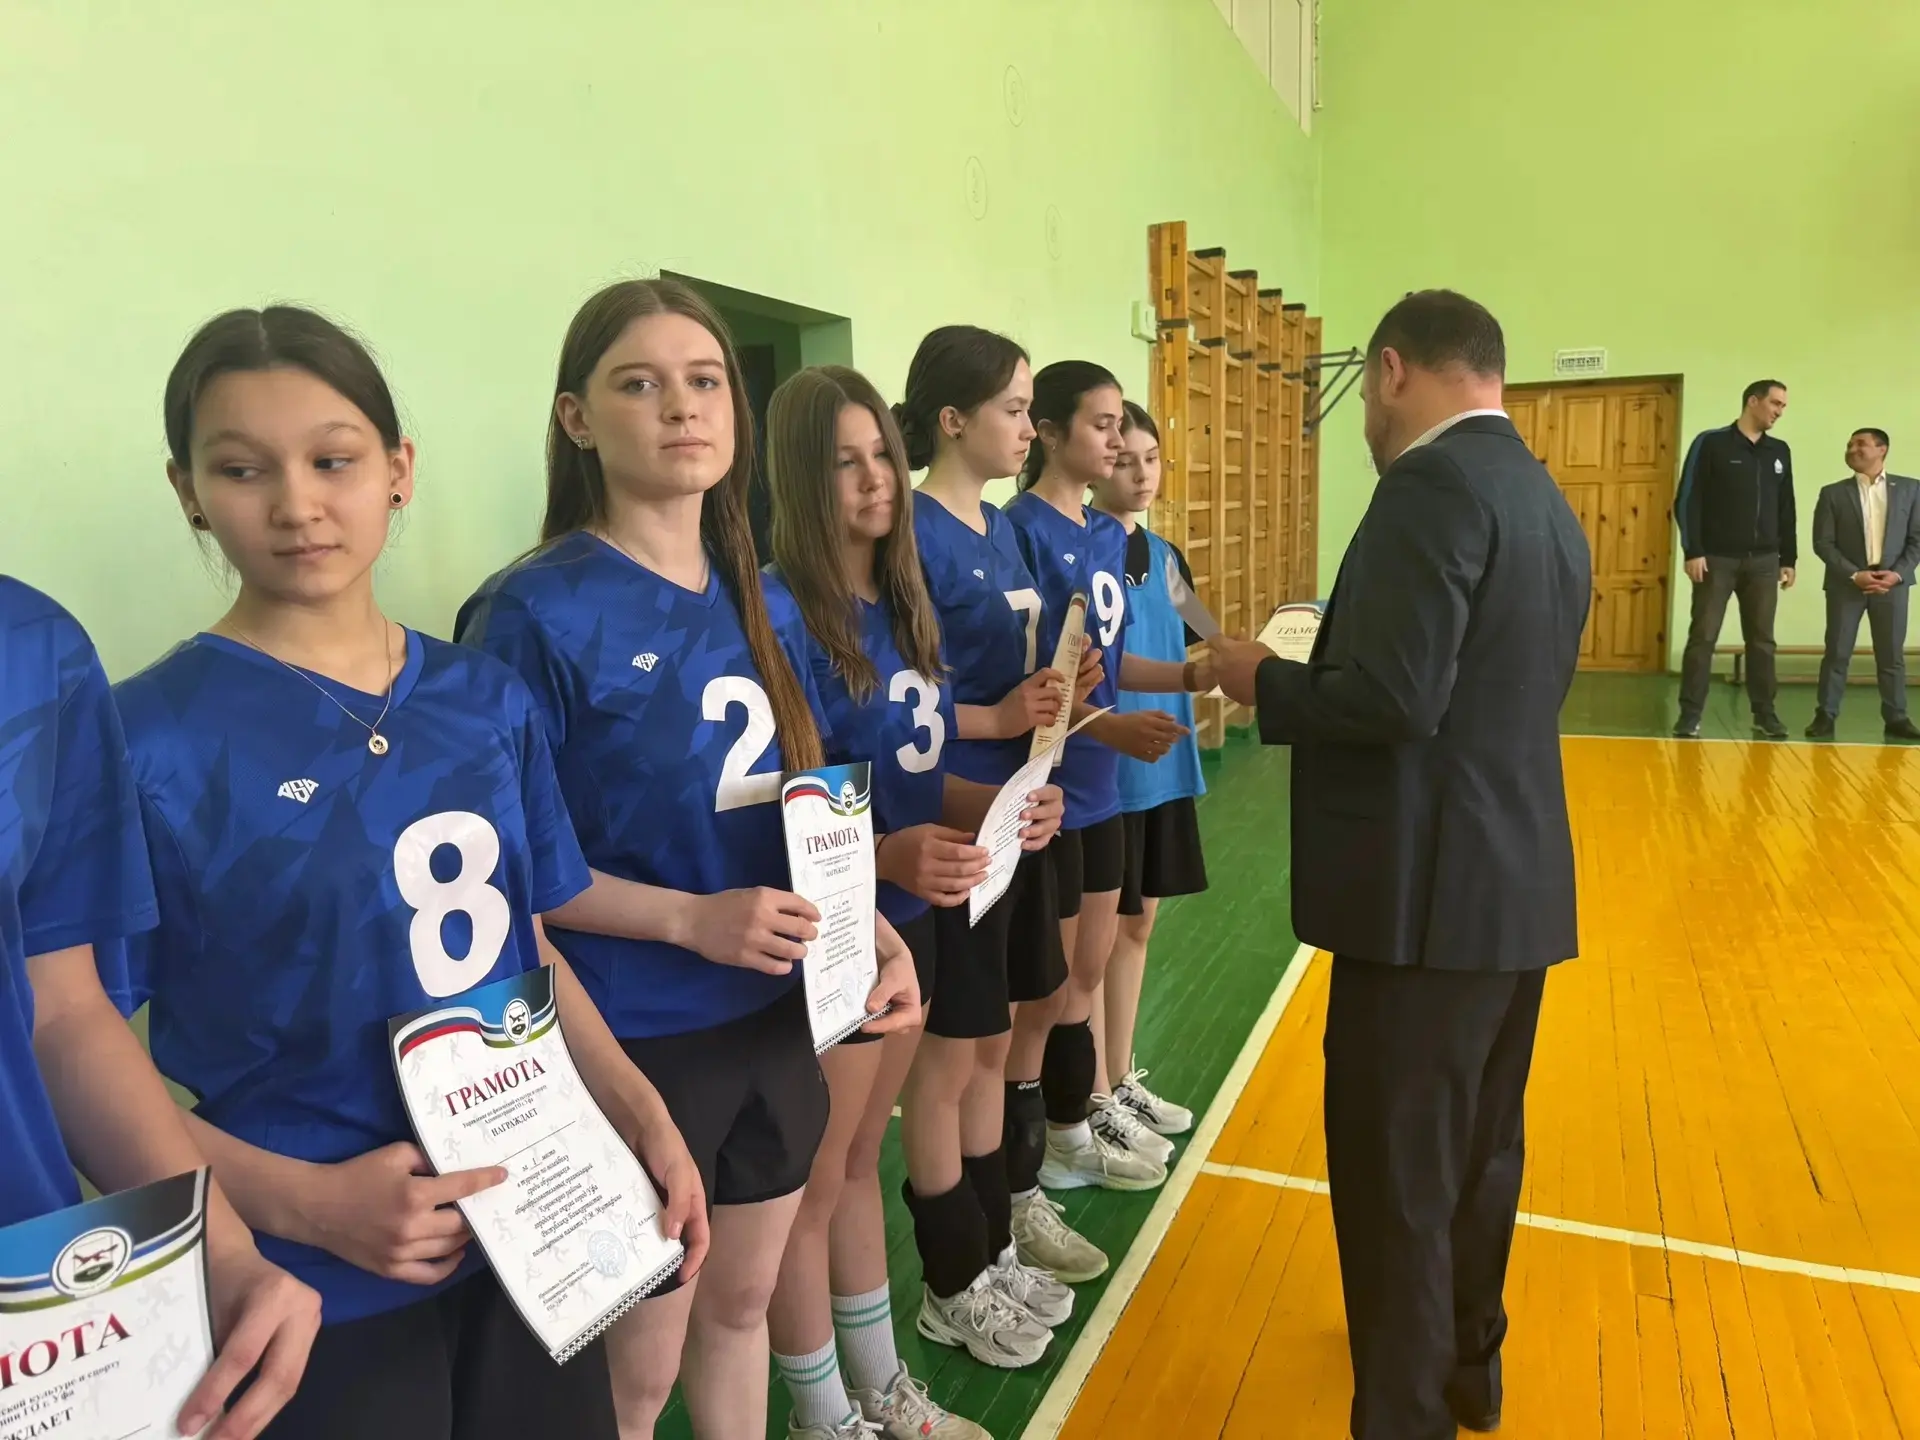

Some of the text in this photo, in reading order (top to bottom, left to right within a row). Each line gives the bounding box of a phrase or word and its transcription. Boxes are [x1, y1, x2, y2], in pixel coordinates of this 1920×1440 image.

[1003, 588, 1041, 675] 7
[1092, 571, 1124, 647] 9
[702, 676, 783, 813] 2
[888, 670, 945, 773] 3
[806, 827, 860, 854] ГРАМОТА
[394, 811, 510, 998] 8
[445, 1057, 546, 1116] ГРАМОТА
[491, 1108, 538, 1137] НАГРАЖДАЕТ
[29, 1378, 76, 1403] культуре
[79, 1373, 86, 1382] и
[87, 1360, 120, 1379] спорту
[52, 1389, 75, 1404] Уфа
